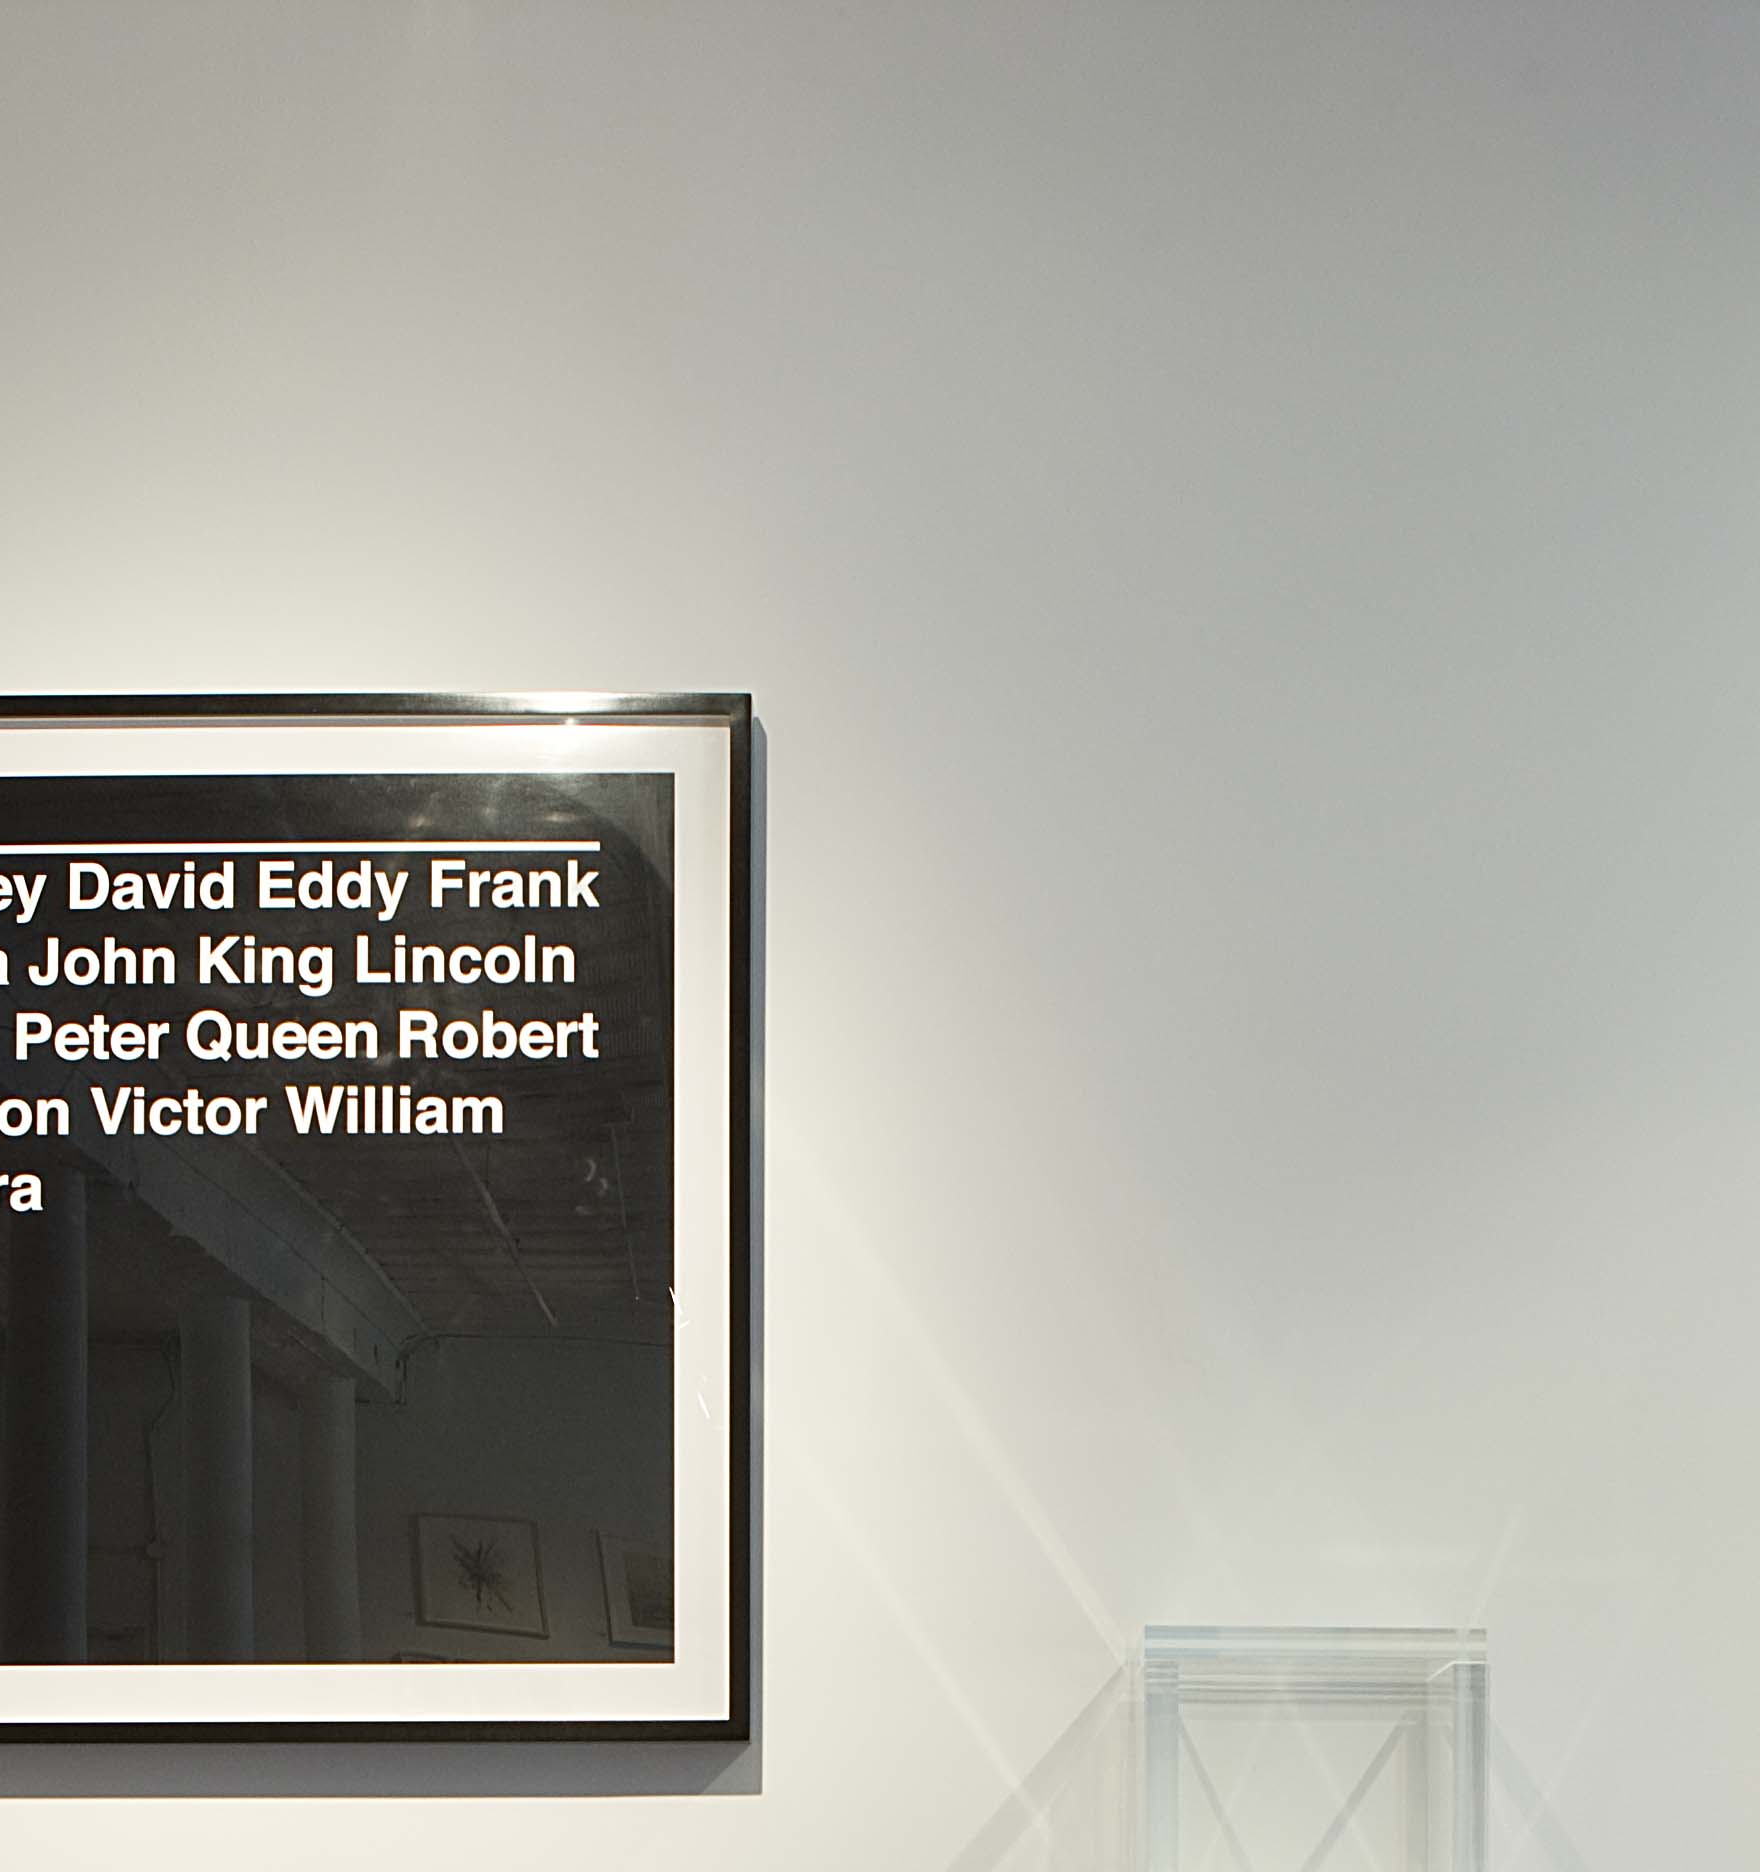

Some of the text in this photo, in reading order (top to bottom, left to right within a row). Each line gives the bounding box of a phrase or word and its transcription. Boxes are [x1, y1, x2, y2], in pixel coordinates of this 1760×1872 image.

[68, 860, 235, 912] David
[258, 859, 410, 923] Eddy
[430, 858, 601, 910] Frank
[27, 935, 177, 987] John
[198, 934, 334, 998] King
[355, 933, 576, 985] Lincoln
[14, 1011, 171, 1062] Peter
[185, 1009, 379, 1063] Queen
[398, 1009, 601, 1061] Robert
[89, 1085, 269, 1137] Victor
[284, 1084, 504, 1136] William
